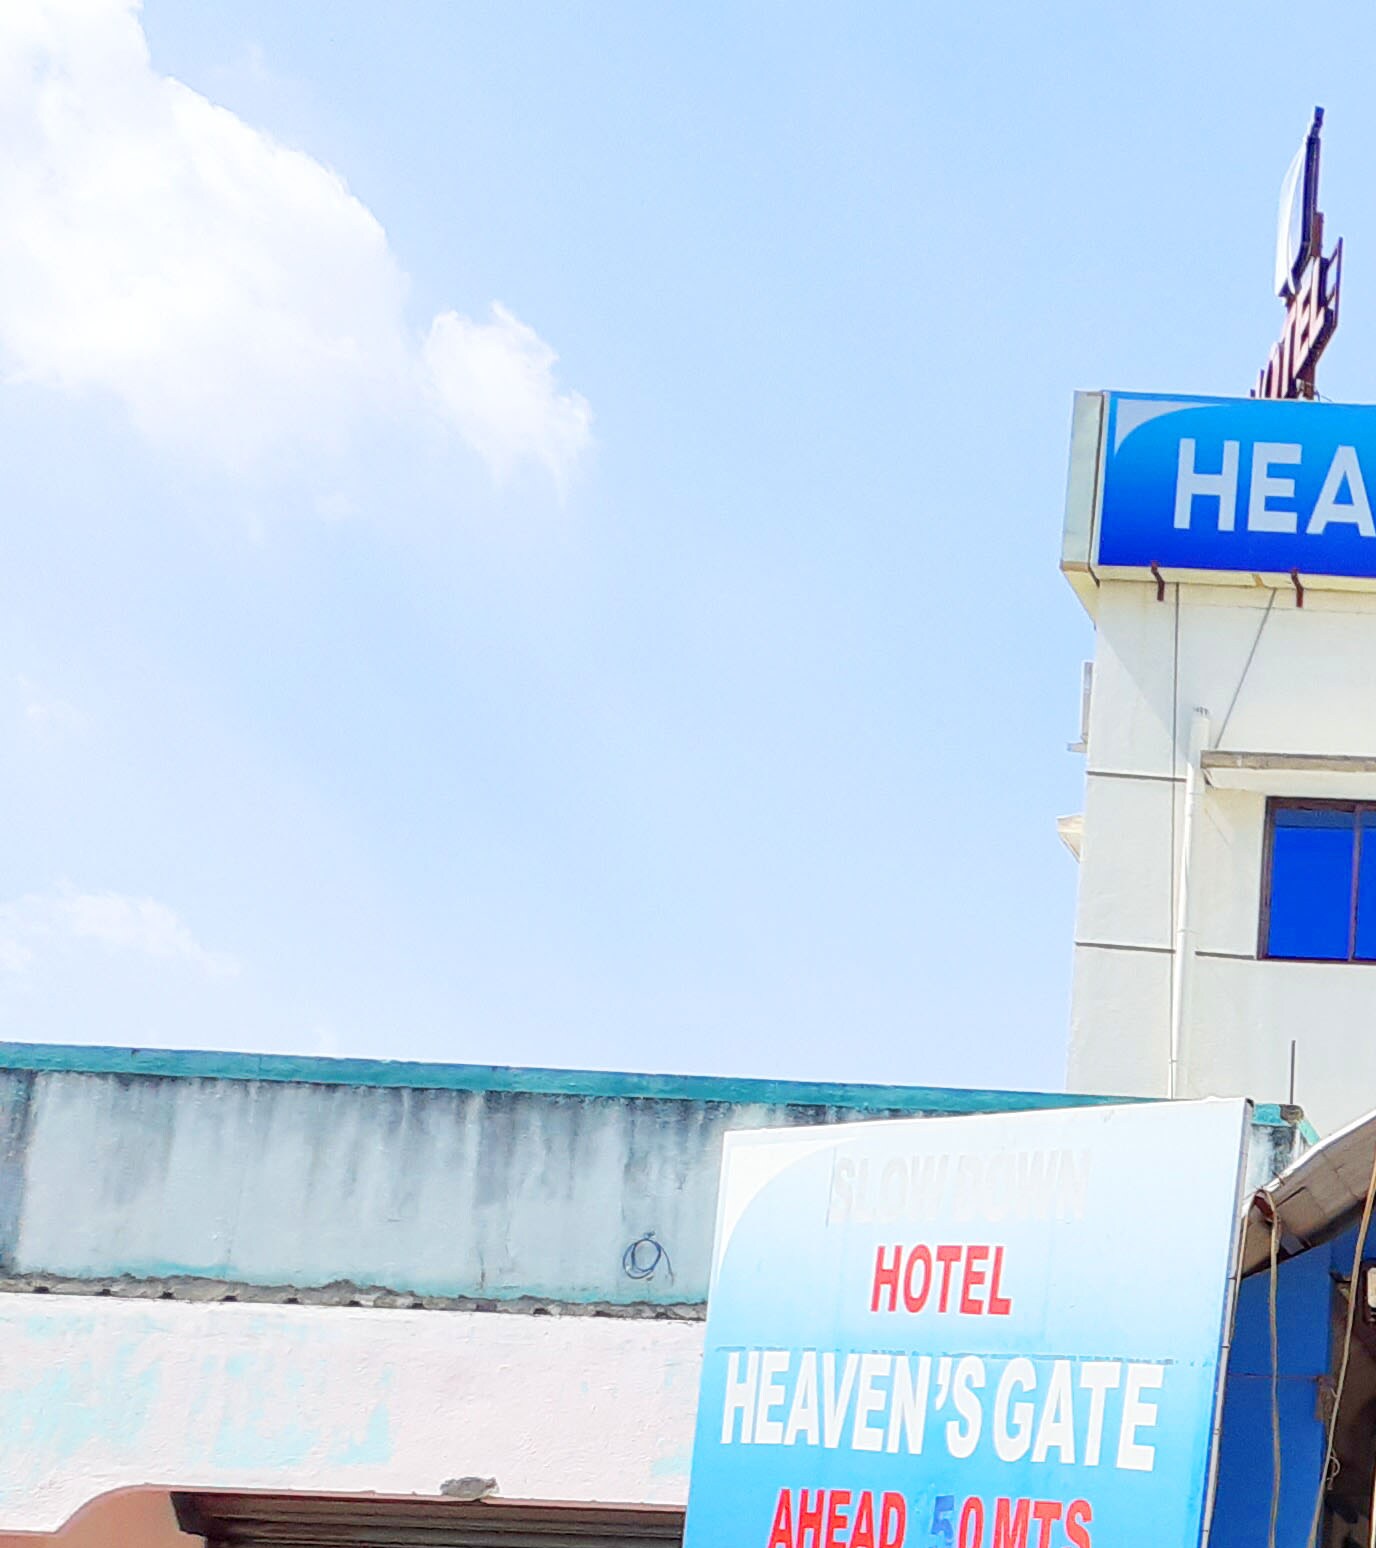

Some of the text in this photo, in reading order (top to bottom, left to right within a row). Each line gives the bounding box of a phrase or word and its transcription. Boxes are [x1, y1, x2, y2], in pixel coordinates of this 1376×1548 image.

[829, 1147, 1092, 1224] SLOW DOWN
[871, 1244, 1013, 1315] HOTEL
[719, 1349, 1166, 1472] HEAVEN'S GATE
